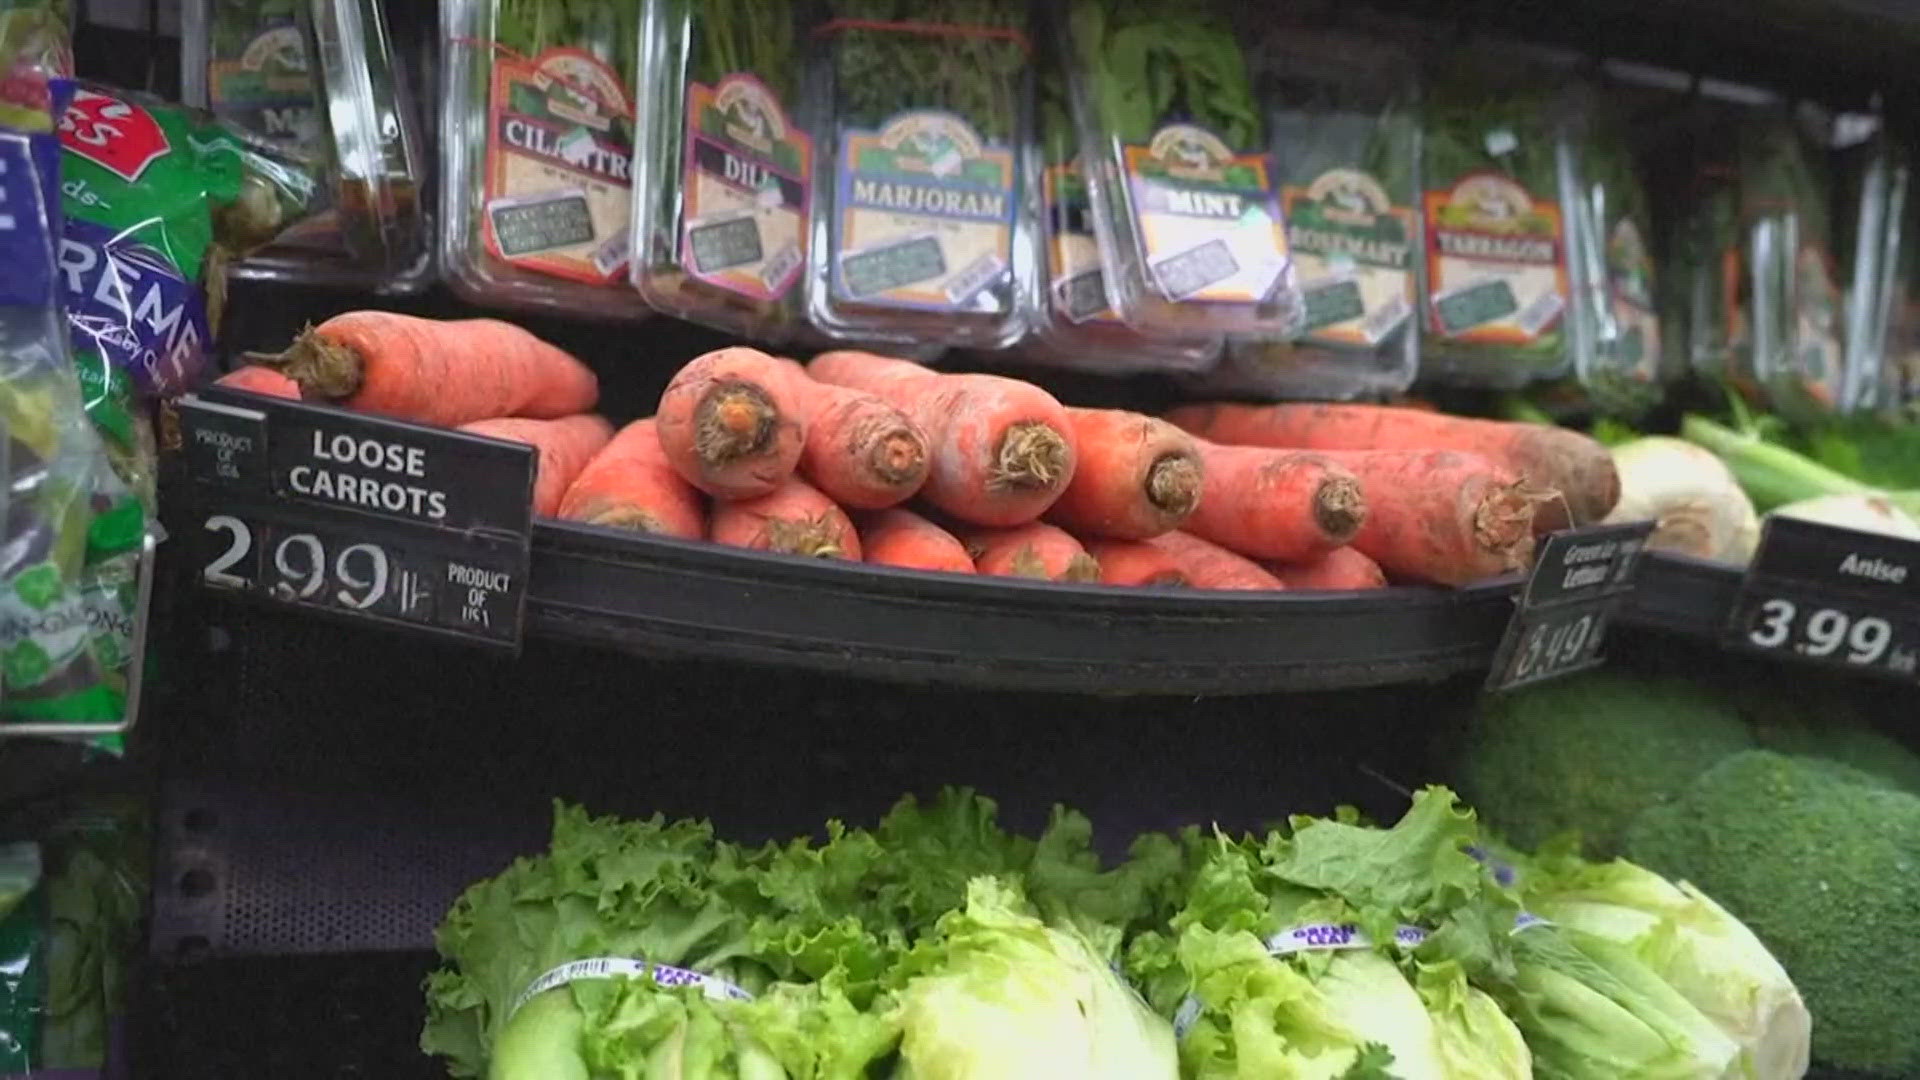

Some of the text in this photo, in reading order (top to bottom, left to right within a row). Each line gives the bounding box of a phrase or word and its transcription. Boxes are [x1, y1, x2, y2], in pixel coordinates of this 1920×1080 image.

[505, 120, 637, 179] CILTR
[854, 179, 1004, 218] MARJORAM
[1166, 190, 1242, 218] MINT
[1437, 232, 1557, 261] TARRAGON
[313, 429, 426, 478] LOOSE
[290, 465, 448, 520] CARROTS
[447, 561, 511, 594] PRODUCT
[1838, 553, 1908, 585] Anise
[468, 587, 489, 608] OF
[1750, 599, 1893, 665] 3.99
